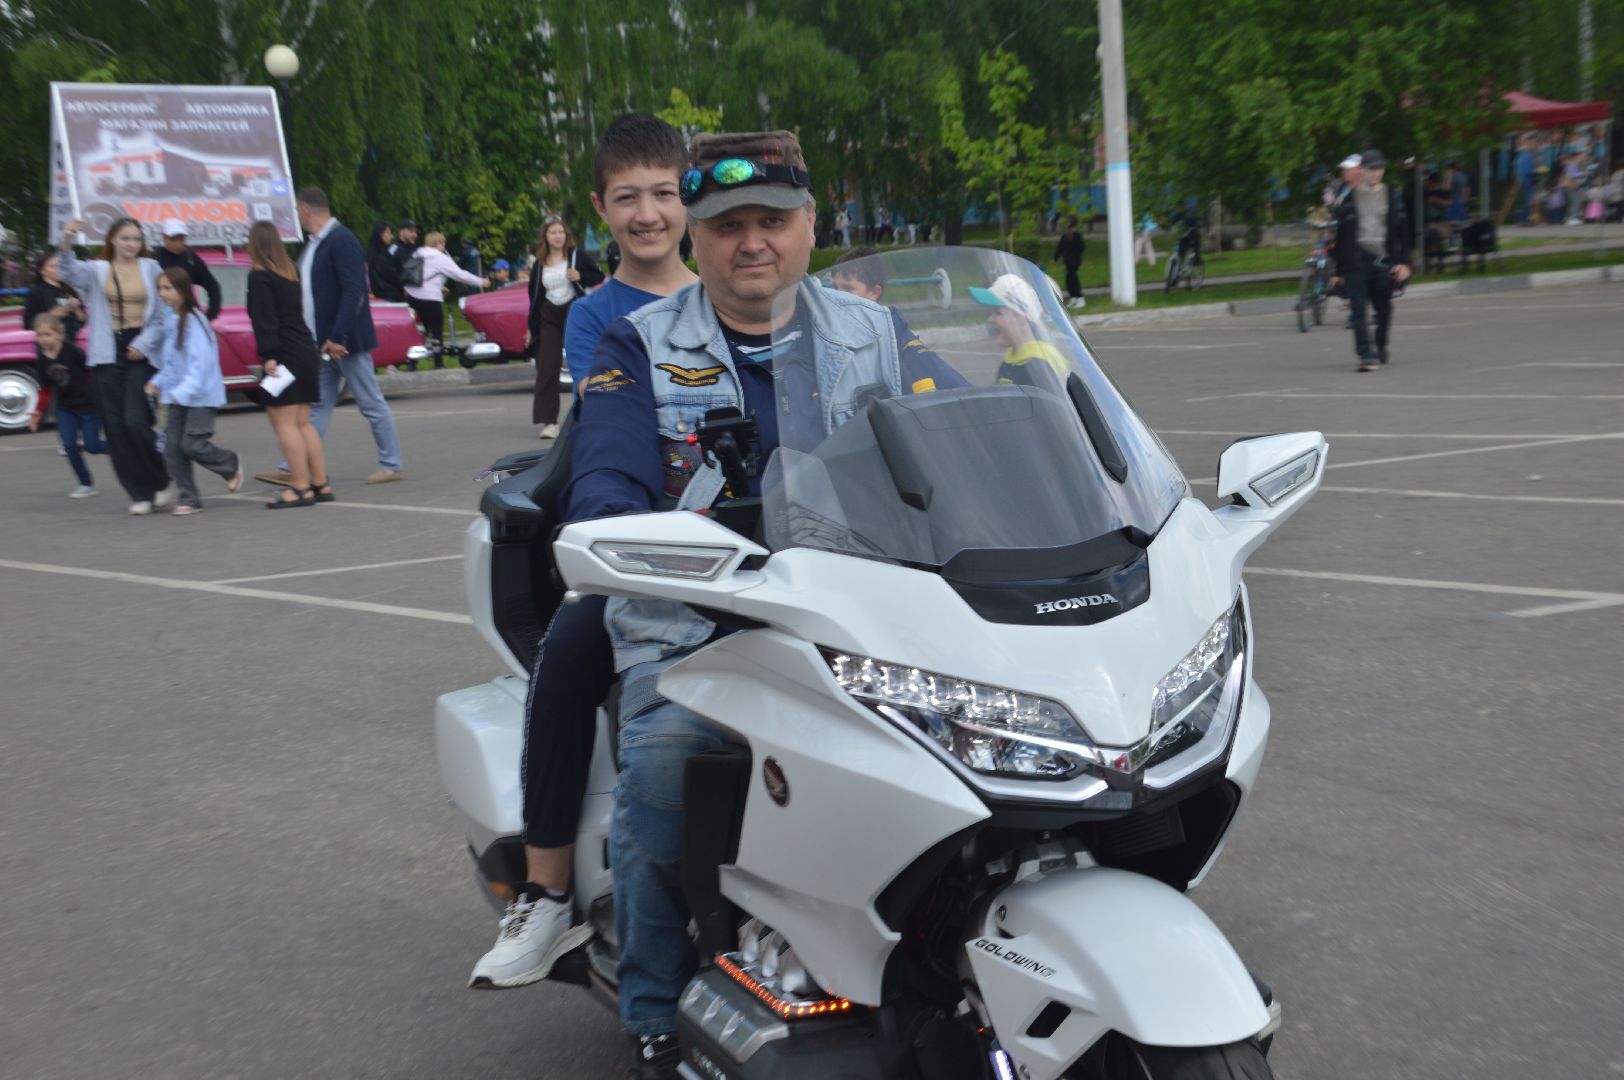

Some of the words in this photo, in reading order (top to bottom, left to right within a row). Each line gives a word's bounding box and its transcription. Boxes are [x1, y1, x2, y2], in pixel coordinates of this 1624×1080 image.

[65, 101, 159, 115] АВТОСЕРВИС
[185, 102, 270, 116] АВТОМОЙКА
[100, 118, 168, 131] МАГАЗИН
[169, 119, 250, 132] ЗАПЧАСТЕЙ
[122, 200, 249, 223] VIANOR
[1034, 593, 1118, 614] HONDA
[975, 939, 1056, 979] GOLDWING
